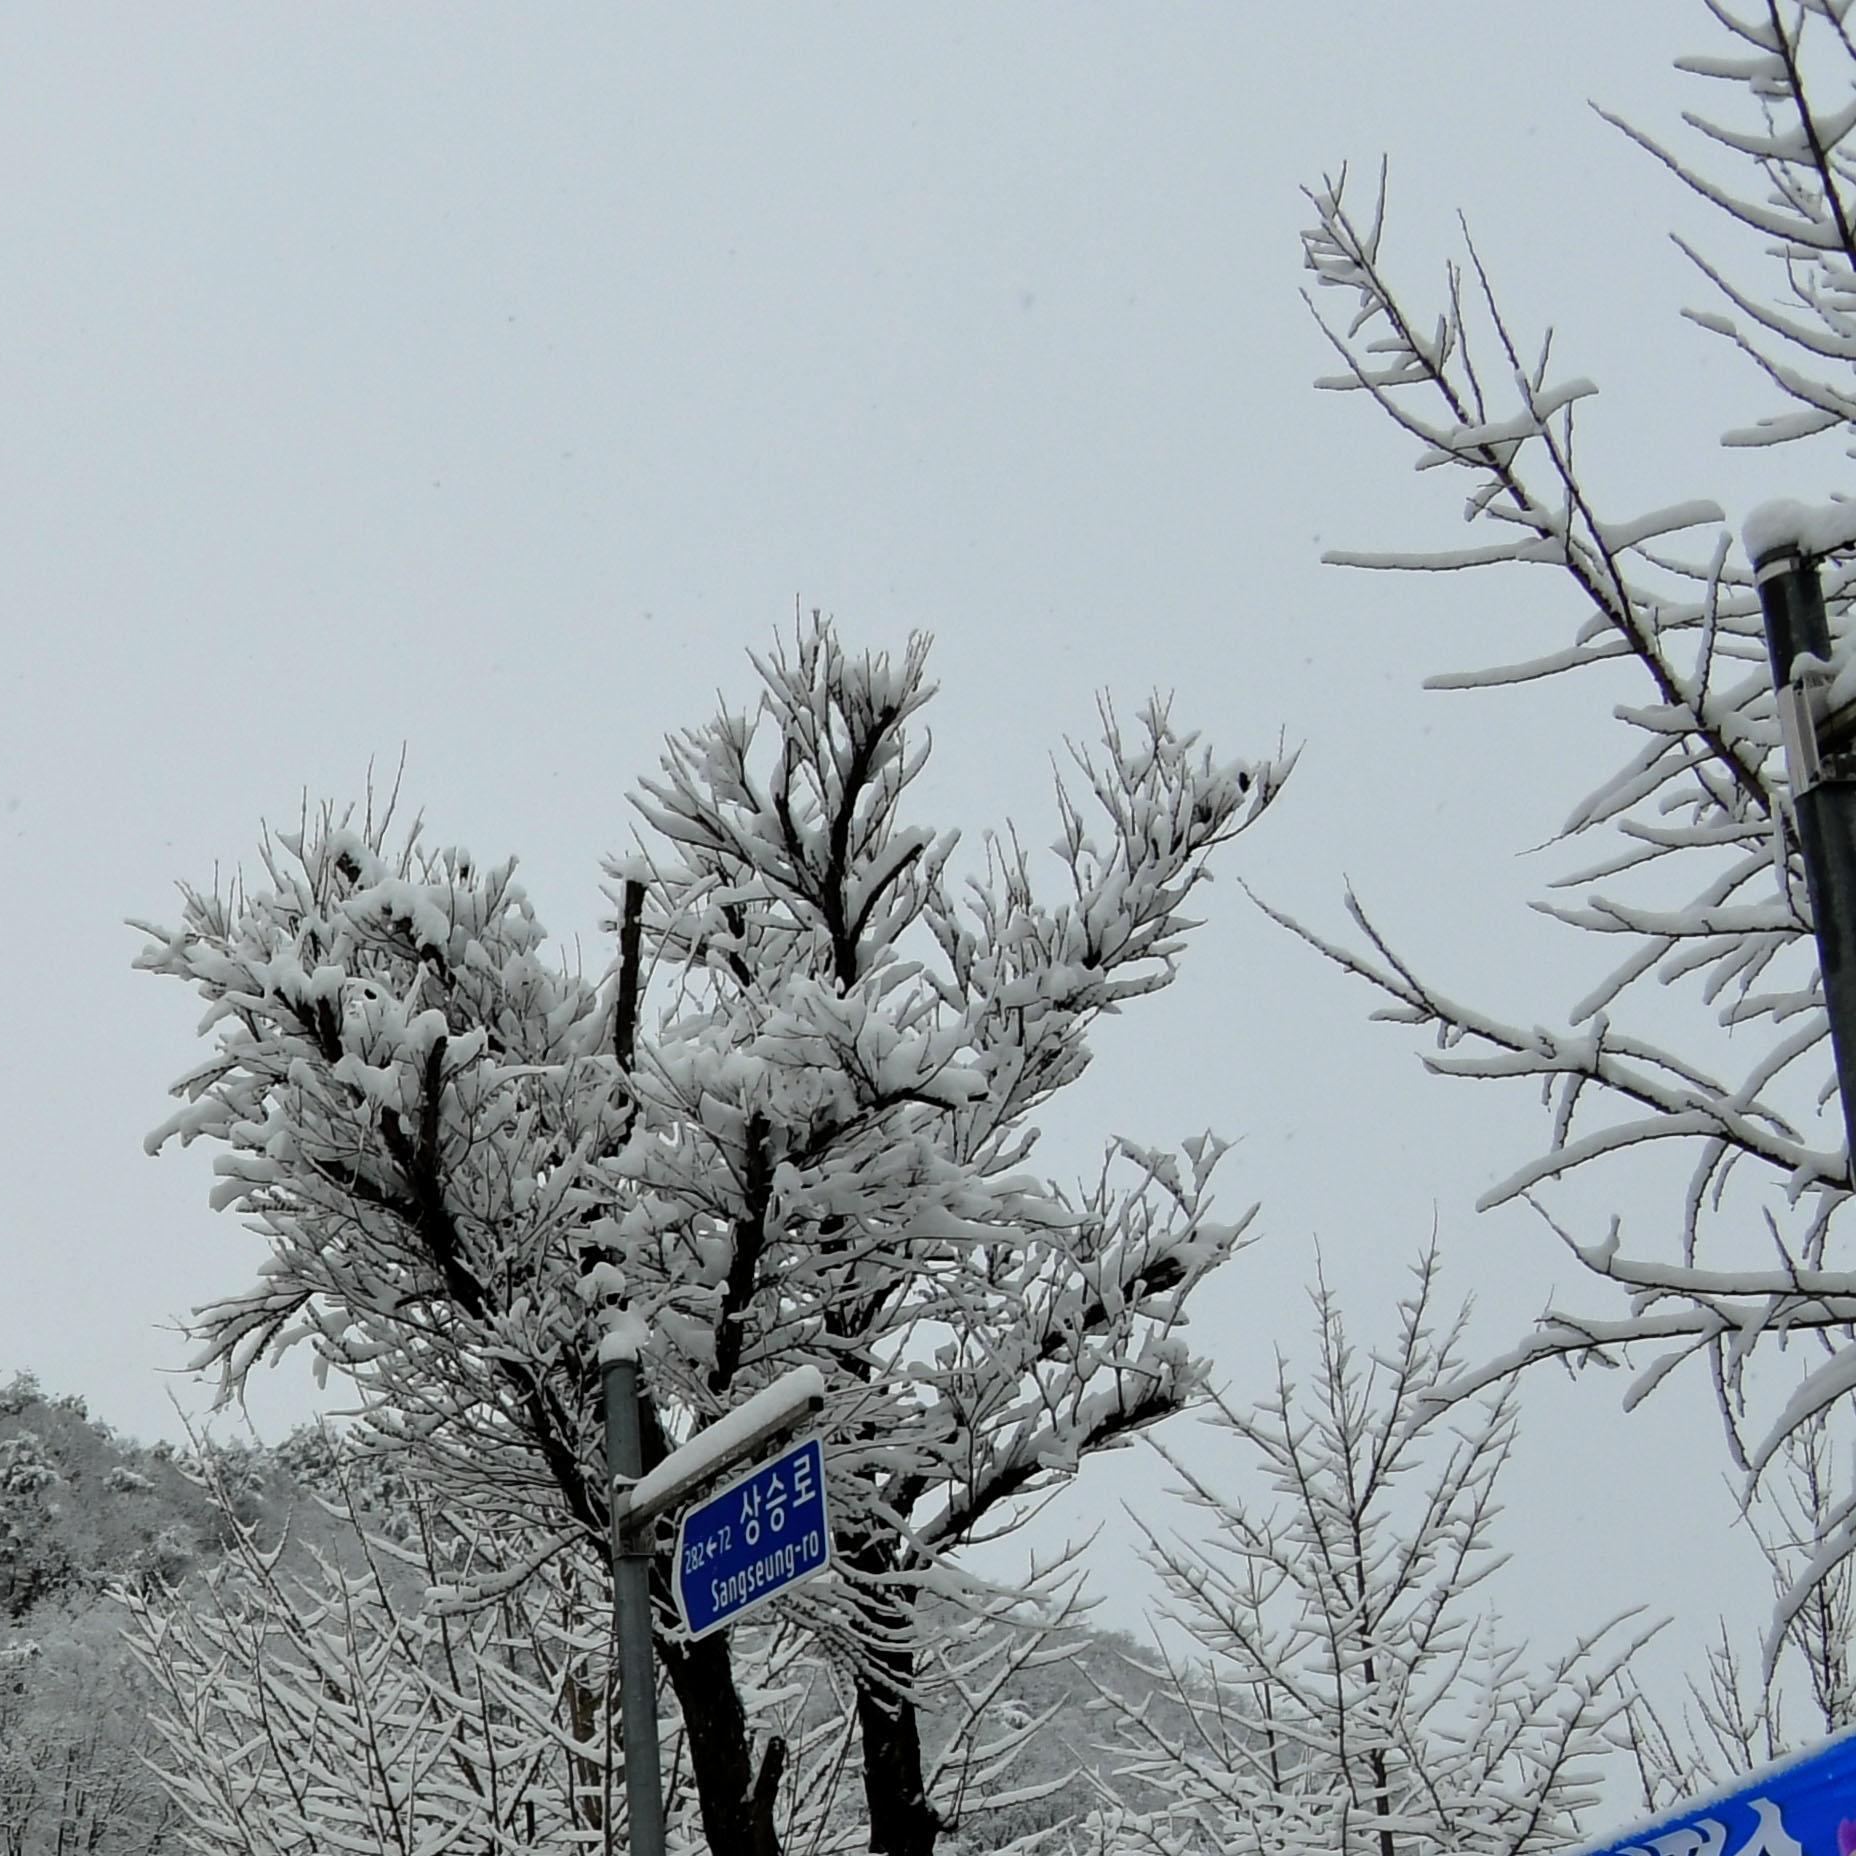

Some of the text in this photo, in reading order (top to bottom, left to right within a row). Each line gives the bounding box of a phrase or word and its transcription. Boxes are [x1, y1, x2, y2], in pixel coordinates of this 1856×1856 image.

[685, 1453, 816, 1575] 282 72 상승로
[711, 1530, 819, 1612] Sangseung-ro
